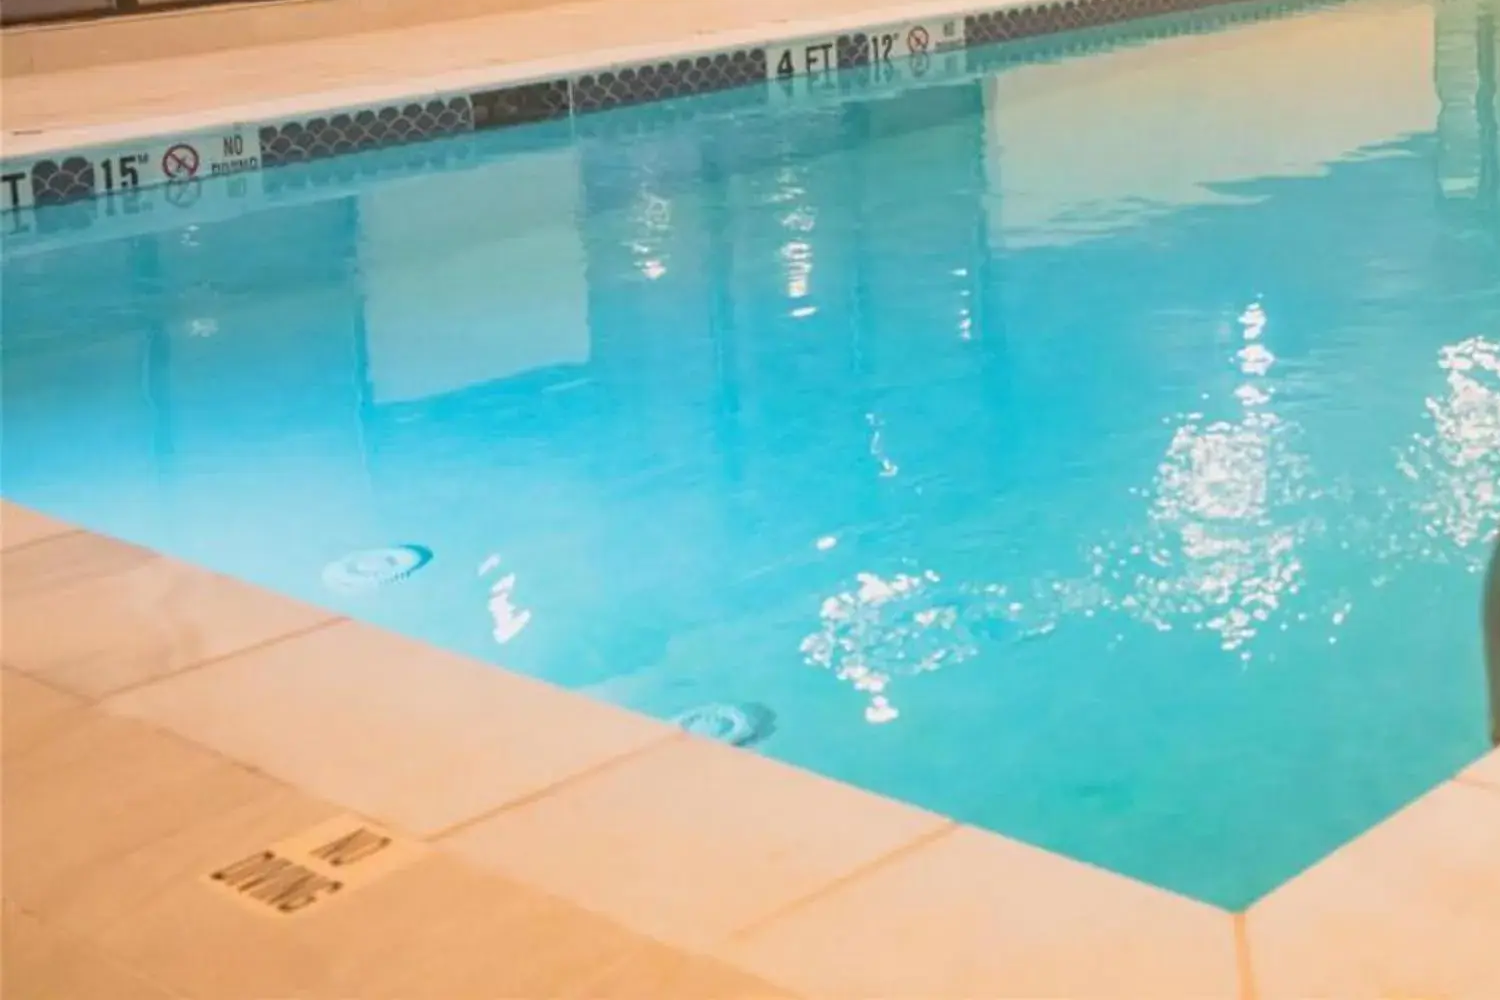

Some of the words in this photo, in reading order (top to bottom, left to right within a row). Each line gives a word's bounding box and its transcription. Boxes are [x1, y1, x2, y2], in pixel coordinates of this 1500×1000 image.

[777, 49, 794, 75] 4
[805, 43, 832, 73] FT
[223, 135, 243, 157] NO
